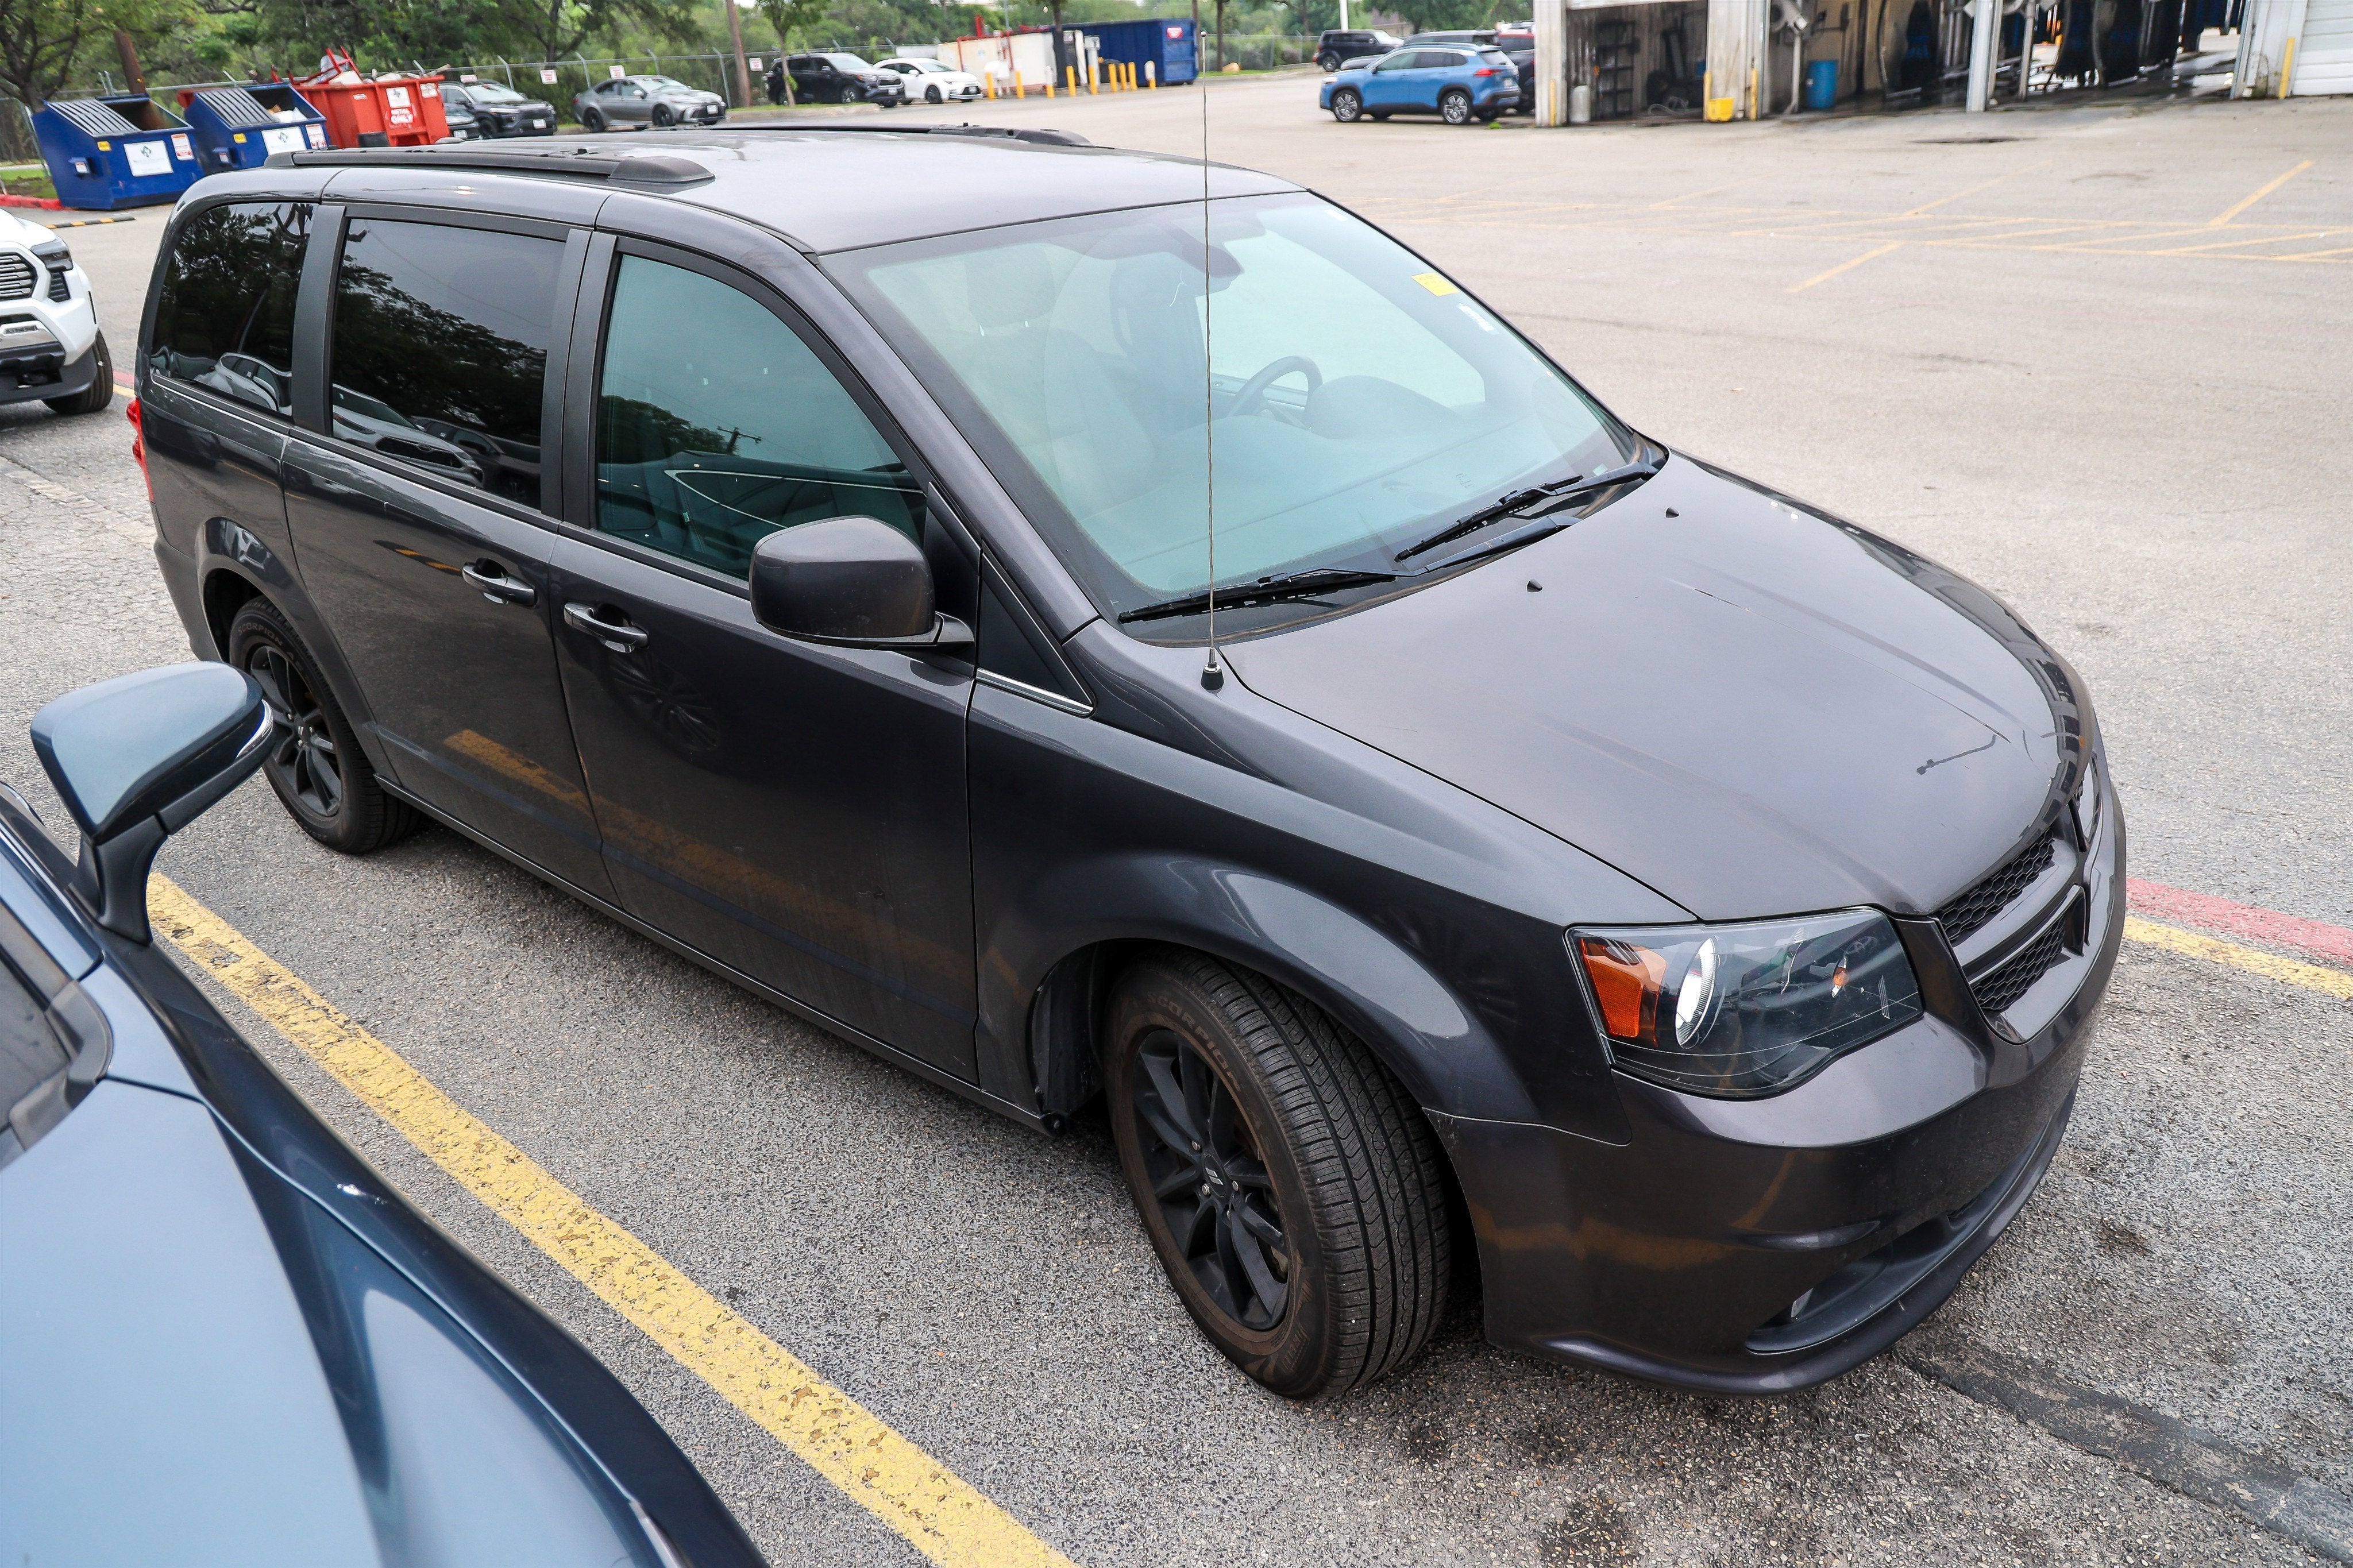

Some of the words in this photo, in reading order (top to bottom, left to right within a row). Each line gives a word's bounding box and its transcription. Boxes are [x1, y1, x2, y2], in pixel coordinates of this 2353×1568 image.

[391, 114, 414, 125] ONLY
[238, 622, 283, 646] SCORPION
[1147, 991, 1245, 1092] SCORPION
